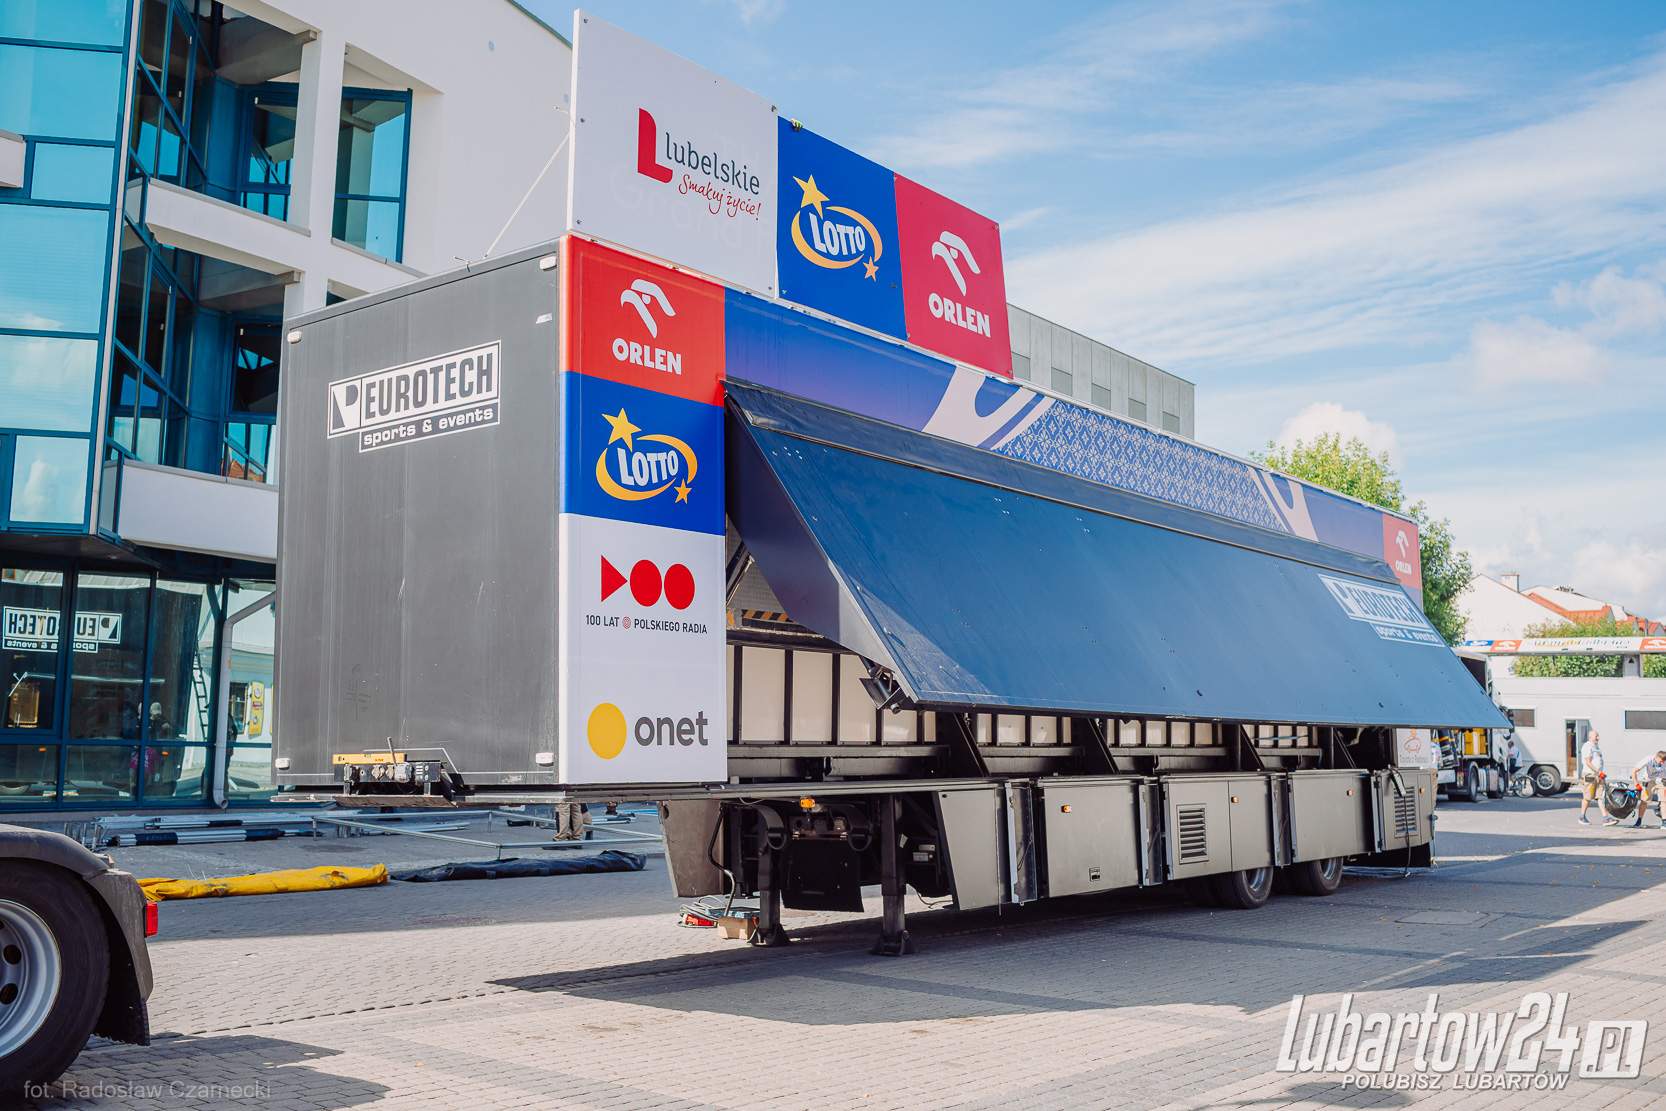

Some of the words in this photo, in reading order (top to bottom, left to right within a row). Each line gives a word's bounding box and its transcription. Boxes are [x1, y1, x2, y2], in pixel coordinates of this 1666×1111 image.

[678, 174, 727, 214] Smakuj
[726, 191, 762, 221] życie!
[808, 211, 866, 257] LOTTO
[928, 292, 991, 339] ORLEN
[612, 337, 682, 375] ORLEN
[365, 352, 493, 420] EUROTECH
[363, 424, 416, 446] sports
[422, 418, 433, 433] &
[438, 408, 493, 430] events
[617, 446, 679, 487] LOTTO
[585, 614, 601, 626] 100
[603, 616, 620, 628] LAT
[633, 618, 680, 632] POLSKIEGO
[682, 623, 708, 634] RADIA
[634, 711, 708, 747] onet
